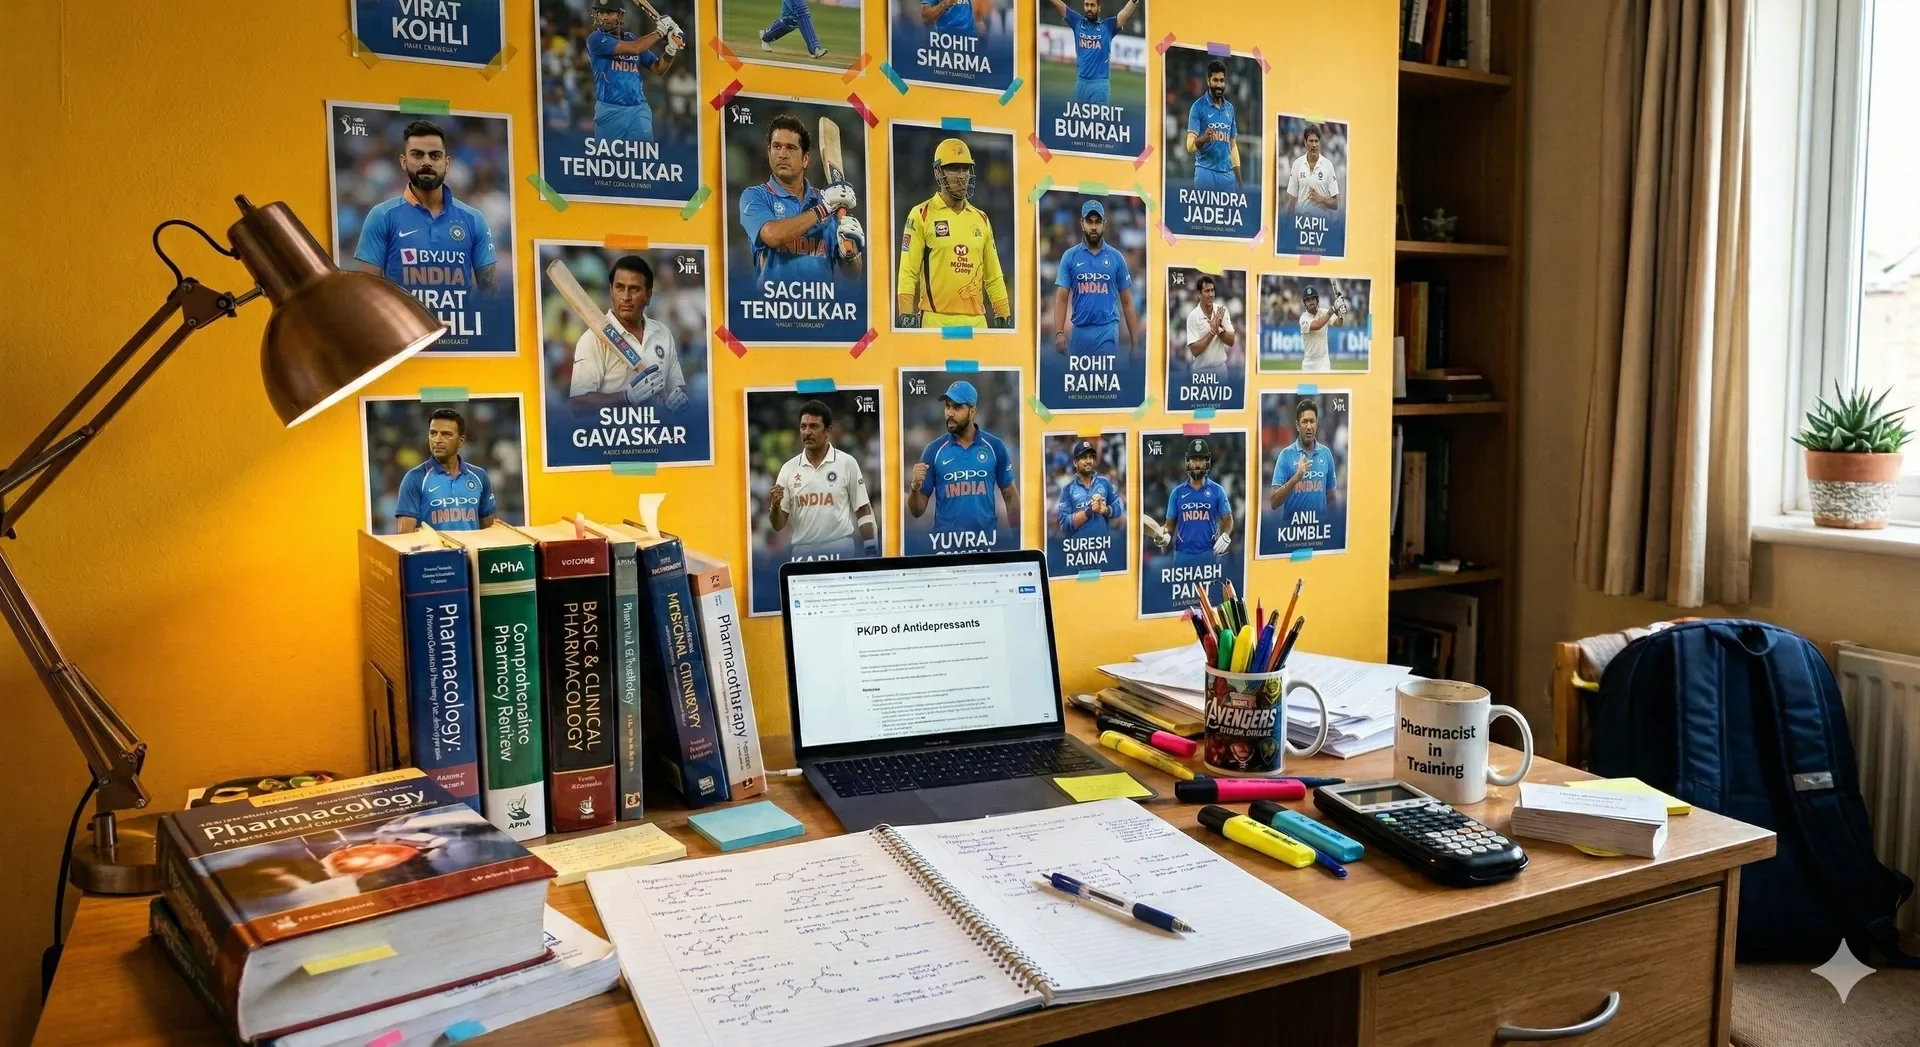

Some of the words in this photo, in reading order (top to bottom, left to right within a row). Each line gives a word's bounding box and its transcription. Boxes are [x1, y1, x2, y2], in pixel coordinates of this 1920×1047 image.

[400, 0, 461, 21] VIRAT
[392, 17, 468, 46] KOHLI
[929, 31, 978, 53] ROHIT
[611, 60, 639, 73] INDIA
[916, 48, 992, 74] SHARMA
[1062, 101, 1124, 123] JASPRIT
[1055, 117, 1130, 144] BUMRAH
[584, 137, 660, 160] SACHIN
[560, 157, 683, 183] TENDULKAR
[1179, 188, 1248, 209] RAVINDRA
[1183, 206, 1243, 227] JADEJA
[1295, 215, 1329, 232] KAPIL
[1299, 231, 1324, 247] DEV
[419, 249, 466, 264] BYJU'S
[402, 266, 465, 287] INDIA
[1076, 273, 1111, 281] oppo
[764, 280, 835, 300] SACHIN
[1077, 282, 1109, 295] INDIA
[740, 300, 857, 321] TENDULKAR
[438, 311, 482, 336] HLI
[1069, 354, 1116, 372] ROHIT
[1192, 373, 1219, 385] RAHL
[1180, 386, 1233, 401] DRAVID
[599, 406, 661, 426] SUNIL
[572, 426, 687, 448] GAVASKAR
[943, 469, 988, 482] oppo
[945, 481, 987, 498] INDIA
[429, 496, 479, 511] oppo
[796, 492, 834, 509] INDIA
[431, 508, 477, 525] INDIA
[1183, 511, 1210, 522] INDIA
[1291, 511, 1320, 526] ANIL
[929, 530, 998, 550] YUVRAJ
[1277, 524, 1331, 543] KUMBLE
[1063, 536, 1111, 552] SURESH
[490, 561, 525, 574] APhA
[1066, 550, 1108, 567] RAINA
[1161, 564, 1222, 584] RISHABH
[582, 601, 598, 651] BASIC
[857, 625, 888, 636] PK/PD
[891, 624, 901, 634] of
[903, 619, 980, 633] Antidepressants
[584, 655, 599, 669] &
[439, 603, 465, 752] Pharmacology:
[563, 602, 583, 752] PHARMACOLOGY
[585, 672, 602, 750] CLINICAL
[1206, 697, 1277, 730] AVENGERS
[1401, 717, 1476, 740] Pharmacist
[1428, 743, 1442, 757] in
[1407, 756, 1464, 779] Training
[202, 788, 425, 841] Pharmacology
